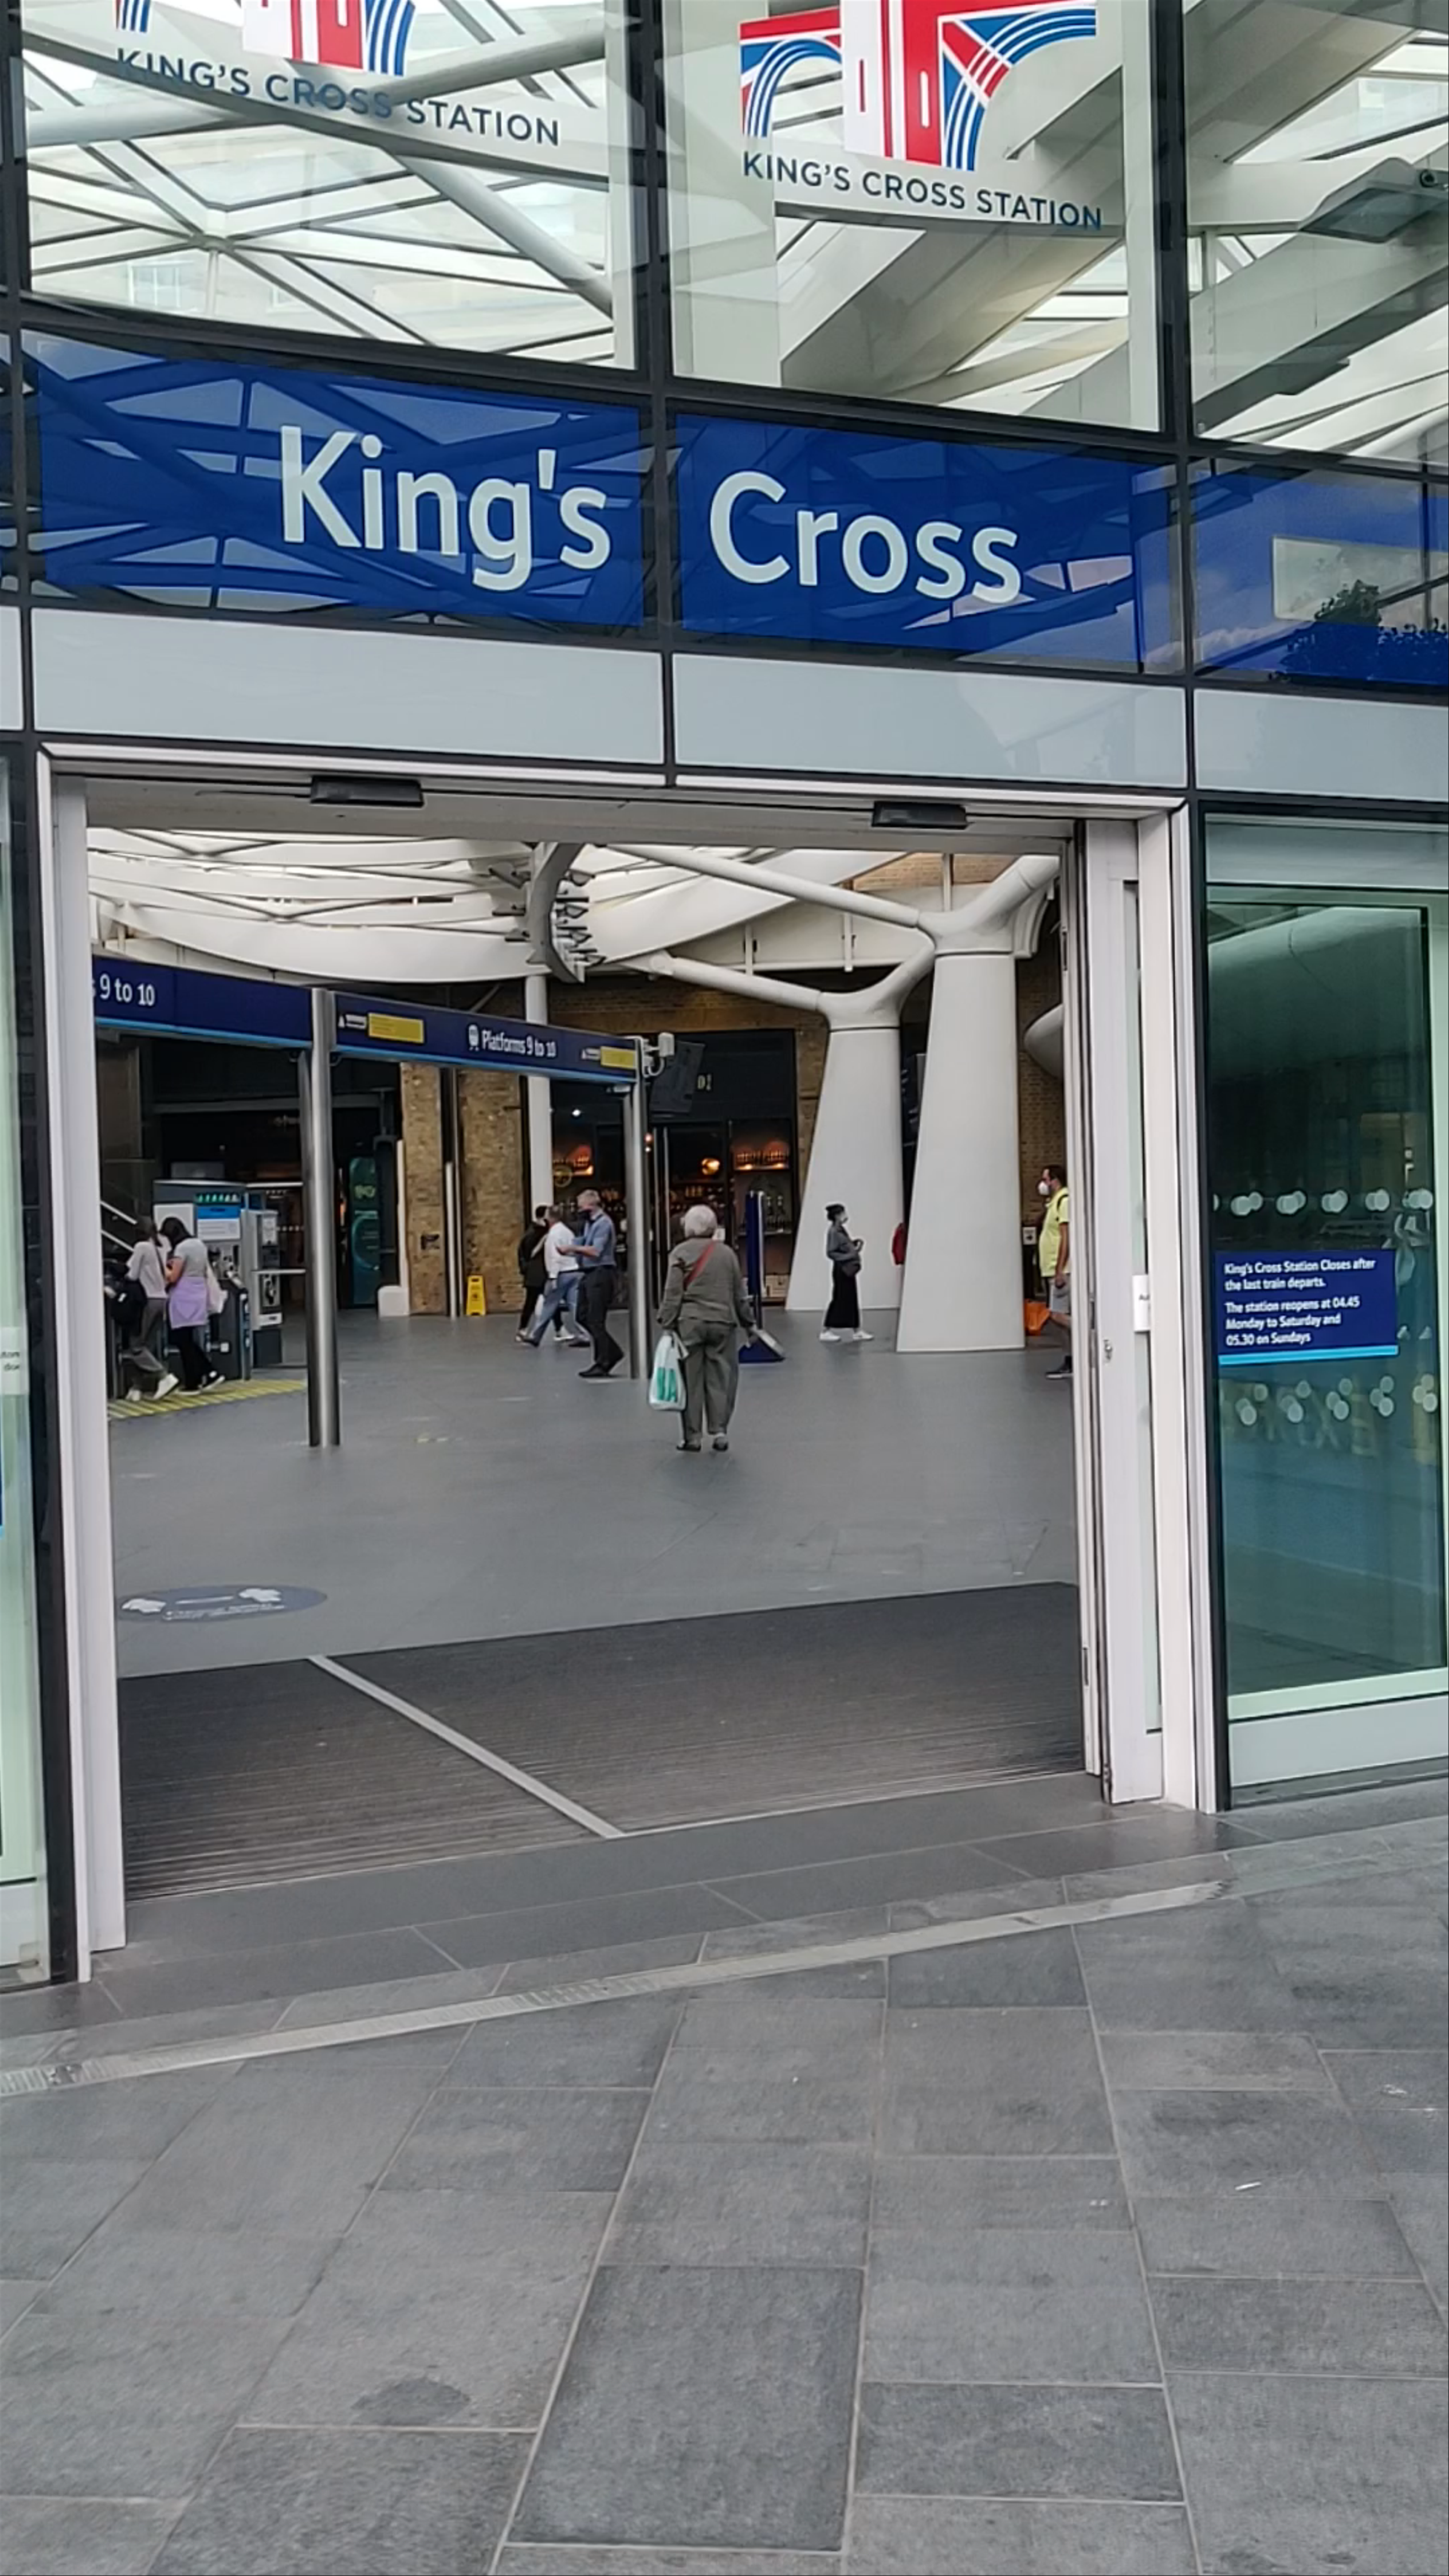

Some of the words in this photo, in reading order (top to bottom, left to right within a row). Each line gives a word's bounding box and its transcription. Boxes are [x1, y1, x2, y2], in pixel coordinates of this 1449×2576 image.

[118, 48, 251, 95] KING'S
[265, 75, 392, 118] CROSS
[407, 98, 558, 146] STATION
[743, 152, 851, 190] KING'S
[863, 171, 965, 209] CROSS
[977, 189, 1101, 230] STATION
[281, 425, 611, 591] King's
[710, 471, 1021, 603] Cross
[100, 973, 110, 1000] 9
[115, 978, 132, 1003] to
[137, 983, 155, 1006] 10
[482, 1030, 526, 1054] Platforms
[526, 1035, 533, 1055] 9
[535, 1038, 544, 1057] to
[546, 1041, 556, 1057] 10
[1224, 1263, 1253, 1277] King's
[1255, 1262, 1281, 1273] Cross
[1284, 1260, 1318, 1273] Station
[1321, 1259, 1351, 1271] Closes
[1353, 1257, 1377, 1269] after
[1225, 1279, 1241, 1291] the
[1243, 1278, 1261, 1289] last
[1263, 1276, 1286, 1289] train
[1287, 1276, 1327, 1290] departs.
[1224, 1302, 1243, 1313] The
[1245, 1300, 1278, 1313] station
[1281, 1300, 1319, 1312] reopens
[1321, 1299, 1331, 1309] at
[1333, 1296, 1360, 1308] 04.45
[1226, 1317, 1264, 1331] Monday
[1266, 1317, 1278, 1327] to
[1279, 1314, 1321, 1327] Saturday
[1323, 1313, 1341, 1325] and
[1226, 1332, 1255, 1346] 05.30
[1257, 1335, 1269, 1345] on
[1271, 1330, 1311, 1345] Sundays
